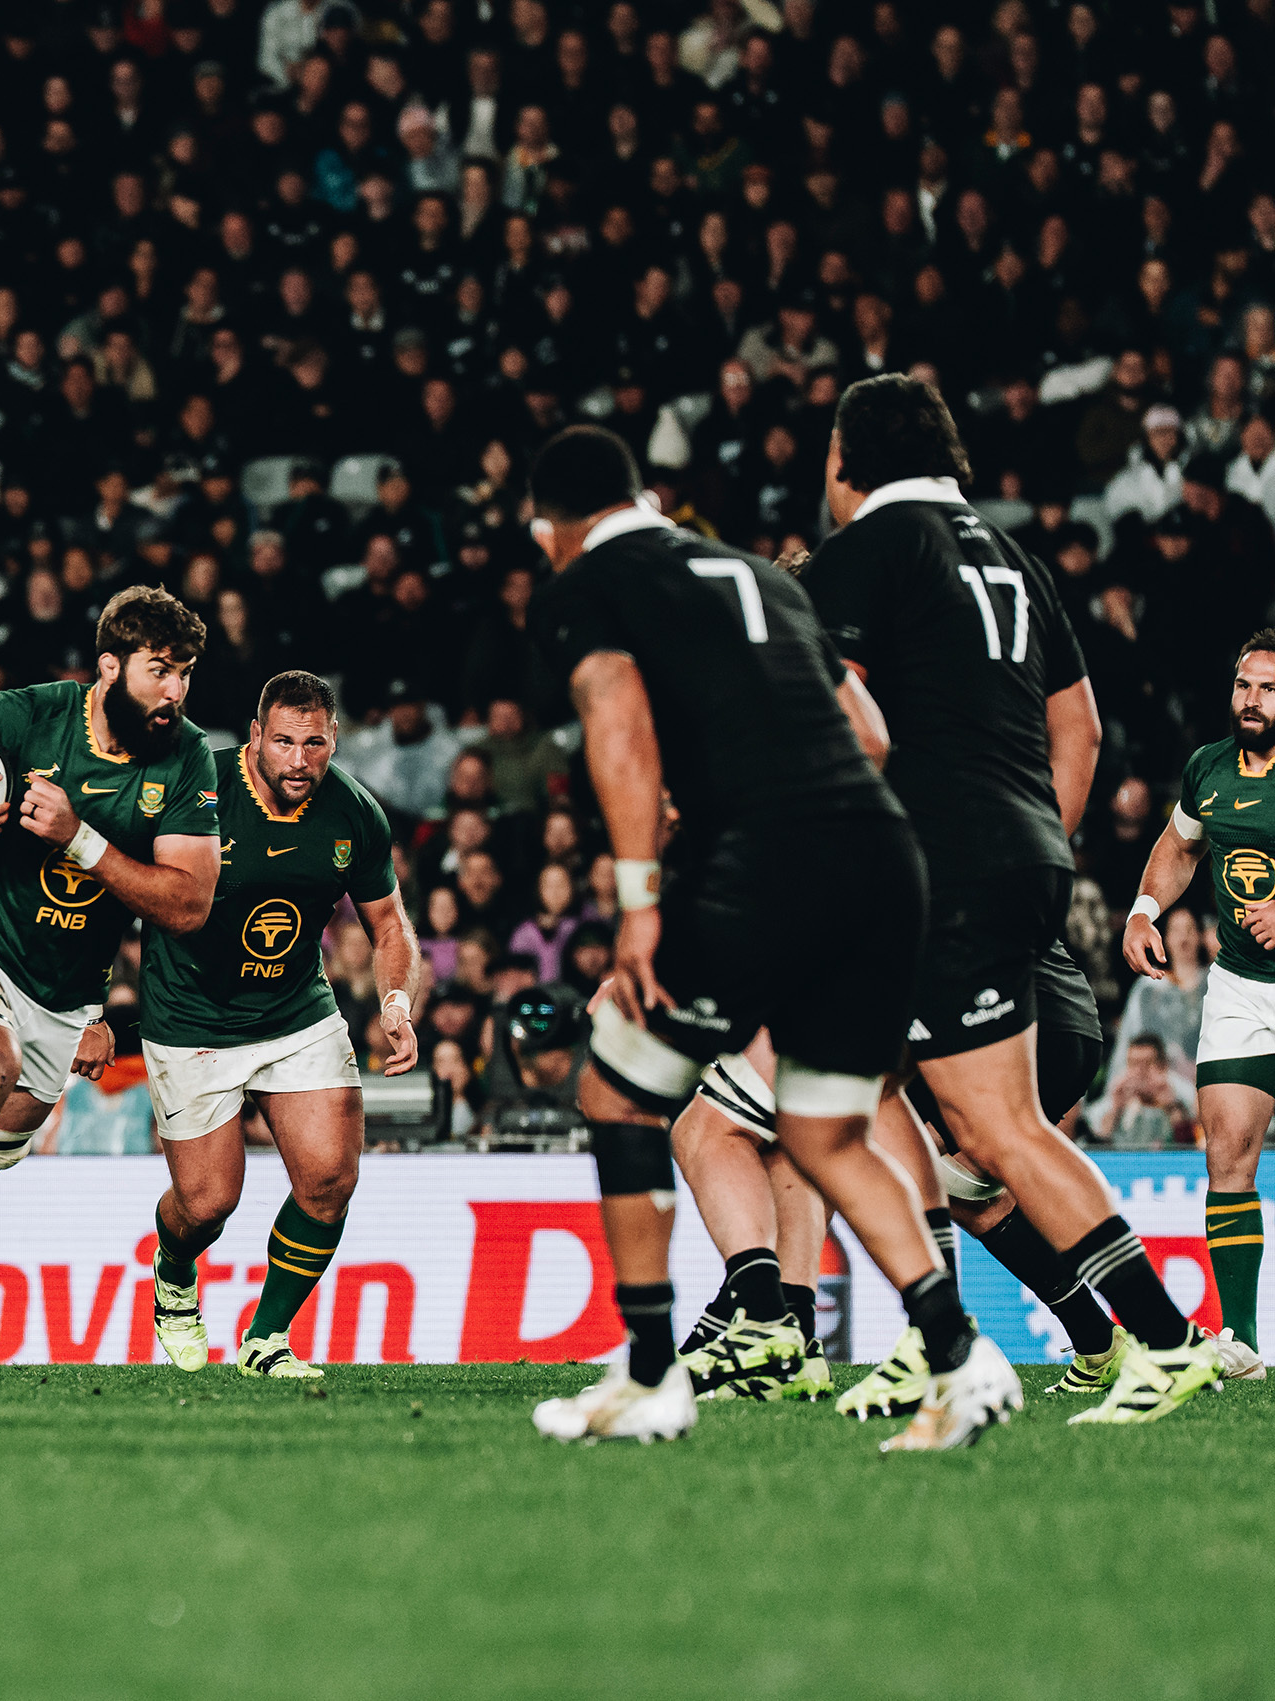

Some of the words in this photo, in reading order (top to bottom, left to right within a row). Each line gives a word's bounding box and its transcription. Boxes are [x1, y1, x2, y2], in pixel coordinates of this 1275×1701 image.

[687, 558, 769, 643] 7
[959, 565, 1030, 663] 17
[36, 906, 87, 930] FNB
[240, 962, 285, 978] FNB
[457, 1201, 628, 1364] D
